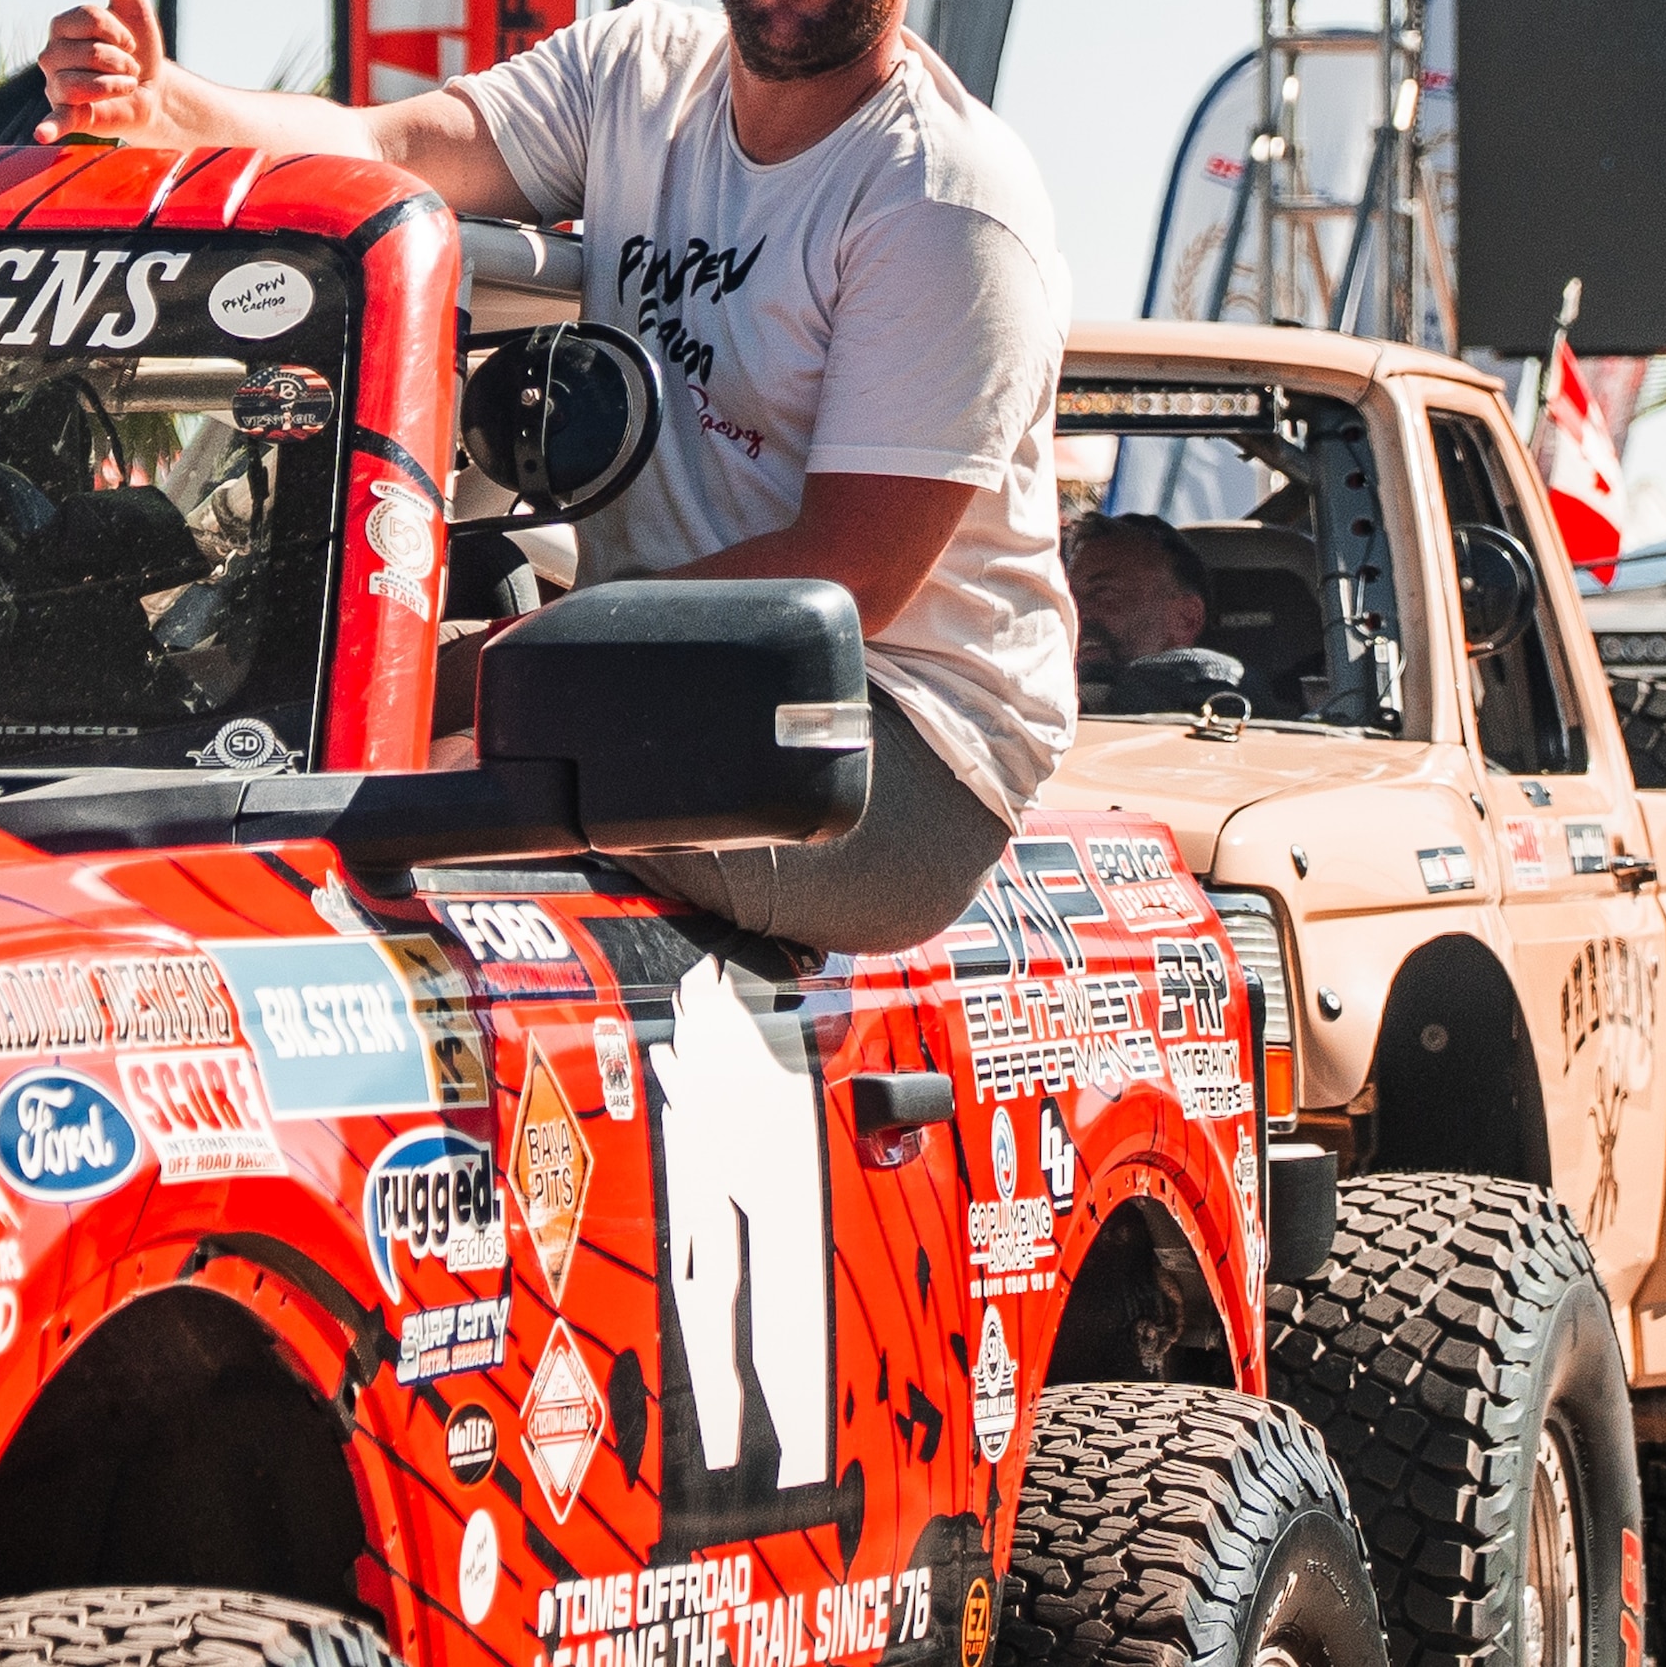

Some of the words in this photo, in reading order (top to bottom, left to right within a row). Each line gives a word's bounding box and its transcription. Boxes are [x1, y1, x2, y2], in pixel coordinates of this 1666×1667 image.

[378, 583, 425, 615] START
[446, 901, 569, 962] FORD
[1111, 883, 1195, 920] DRIVER
[91, 954, 232, 1050] DESIGNS
[253, 983, 407, 1059] BILSTEIN
[961, 973, 1142, 1048] SOUTHWEST
[972, 1031, 1164, 1103] PERFORMANCE
[1167, 1040, 1239, 1082] ANTIGRAVITY
[128, 1056, 263, 1133] SCORE
[1181, 1084, 1242, 1118] BATTERIES
[17, 1085, 115, 1180] Ford
[162, 1137, 271, 1154] INTERNATIONAL
[168, 1152, 232, 1175] OFF-ROAD
[235, 1151, 282, 1170] RACING
[377, 1149, 493, 1248] rugged
[535, 1166, 574, 1210] PITS
[988, 1198, 1053, 1239] PLUMBING
[448, 1232, 505, 1269] radios
[396, 1304, 454, 1383] SURF
[456, 1295, 510, 1364] CITY
[555, 1572, 633, 1639] TOMS
[635, 1553, 752, 1625] OFFROAD
[671, 1610, 730, 1667] THE
[734, 1593, 810, 1667] TRAIL
[815, 1574, 892, 1663] SINCE
[966, 1598, 986, 1641] EZ
